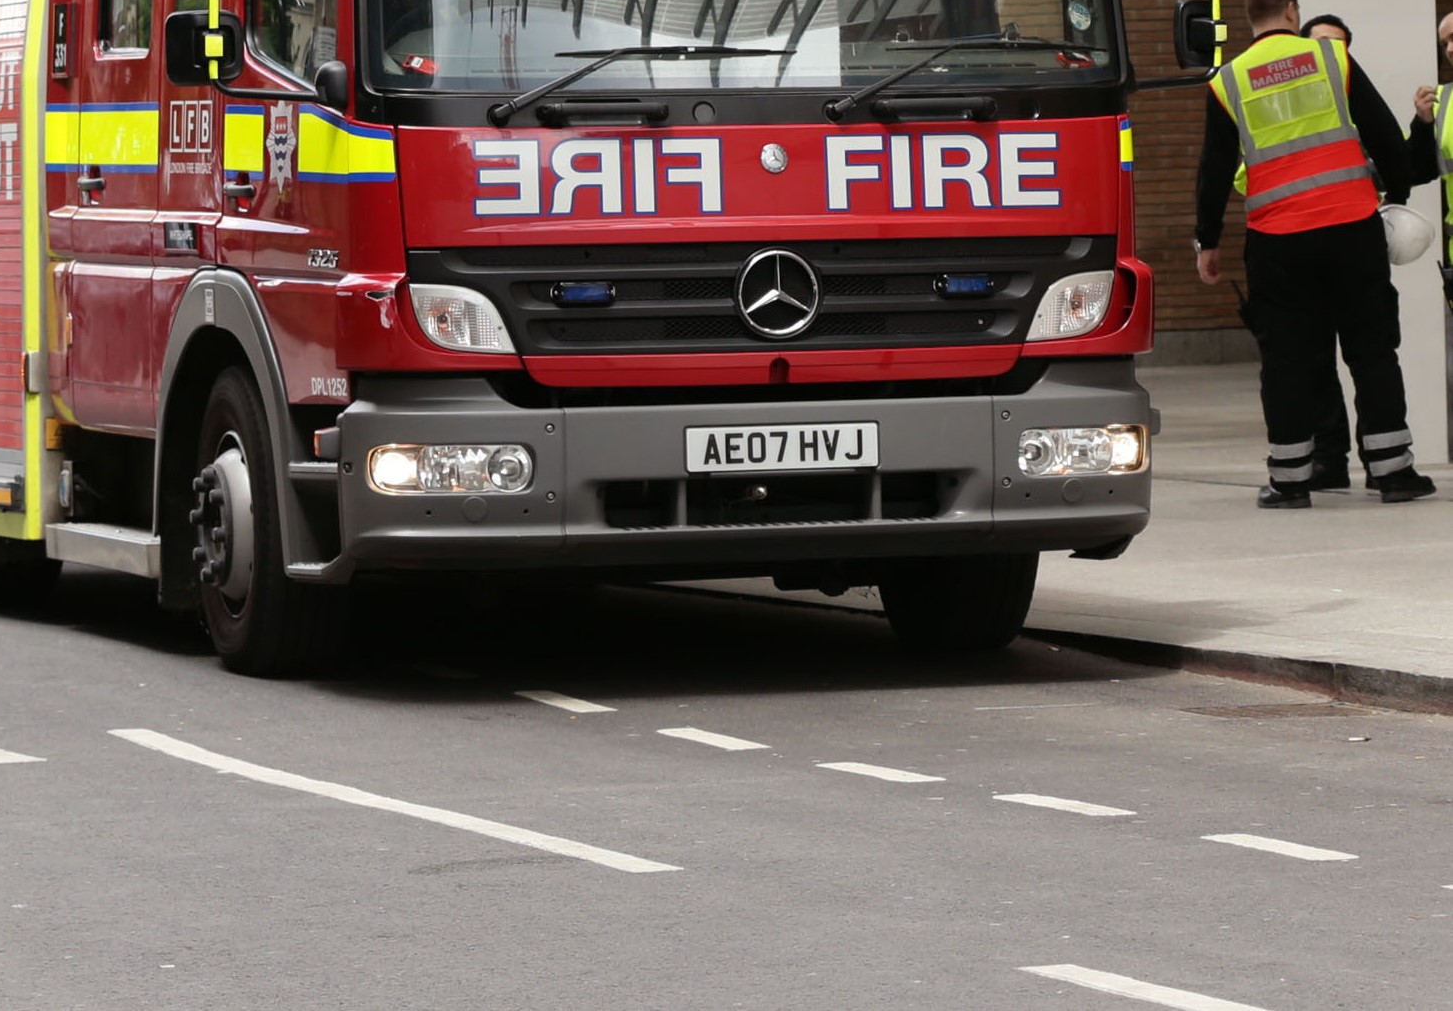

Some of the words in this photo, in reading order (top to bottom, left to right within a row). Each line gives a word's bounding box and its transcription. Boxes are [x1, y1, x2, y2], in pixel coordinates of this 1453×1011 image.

[54, 43, 67, 67] 331
[1267, 58, 1294, 73] FIRE
[1252, 63, 1315, 89] MARSHAL
[172, 107, 211, 145] LFB
[824, 131, 1062, 212] FIRE
[311, 376, 348, 397] DPL1252
[703, 431, 788, 465] AE07
[799, 428, 863, 462] HVJ
